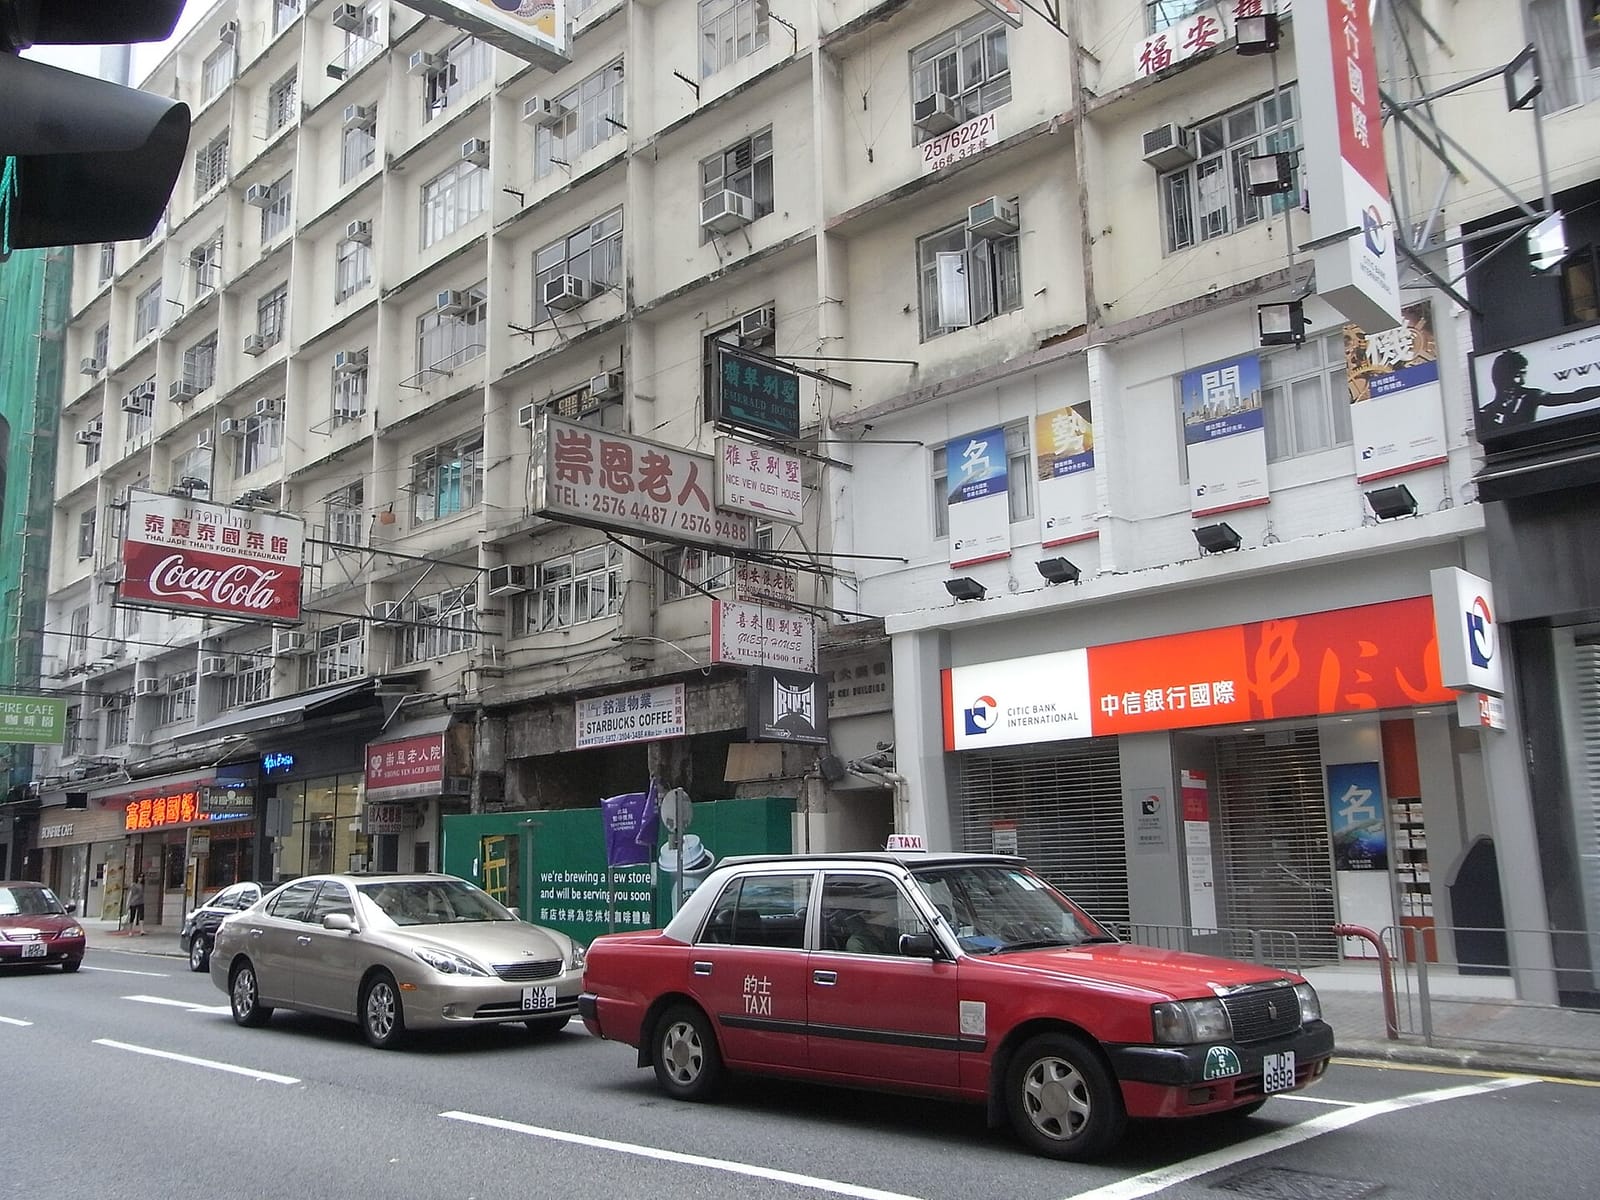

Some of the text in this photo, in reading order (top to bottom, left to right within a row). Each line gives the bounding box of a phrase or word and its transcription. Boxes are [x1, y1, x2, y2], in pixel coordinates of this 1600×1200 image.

[924, 114, 995, 162] 25762221
[725, 444, 800, 484] 雅景別墅
[960, 439, 990, 477] 名
[554, 428, 752, 521] 崇恩老人
[725, 474, 741, 488] NICE
[759, 483, 779, 498] GUEST
[780, 487, 801, 502] HOUSE
[731, 493, 745, 505] 5/F
[592, 493, 626, 517] 2576
[630, 501, 668, 526] 4487
[680, 512, 711, 534] 2576
[715, 523, 747, 543] 9488
[145, 533, 287, 562] THAI JADE THAI'S FOOD RESTAURANT
[149, 554, 283, 609] Coca-Cola
[737, 632, 803, 652] GUEST HOUSE
[25, 703, 55, 716] CAFE
[778, 689, 811, 717] RING
[1007, 703, 1057, 717] CITIC BANK
[1100, 680, 1236, 718] 中信銀行國際
[586, 716, 636, 735] STARBUCKS
[638, 710, 673, 727] COFFEE
[1007, 713, 1079, 728] INTERNATIONAL
[1338, 783, 1377, 825] 名
[898, 836, 922, 849] TAXI
[540, 871, 563, 883] we're
[564, 869, 598, 885] brewing
[600, 872, 606, 883] a
[628, 871, 651, 883] store
[540, 886, 555, 899] and
[556, 887, 570, 900] will
[571, 887, 581, 900] be
[614, 891, 628, 903] you
[630, 891, 651, 901] soon
[532, 986, 547, 998] NX
[743, 974, 772, 995] 的士
[524, 997, 554, 1009] 6982
[742, 994, 772, 1016] TAXI
[1211, 1048, 1230, 1057] TAXI
[1218, 1055, 1226, 1067] 5
[1265, 1070, 1293, 1092] 9992
